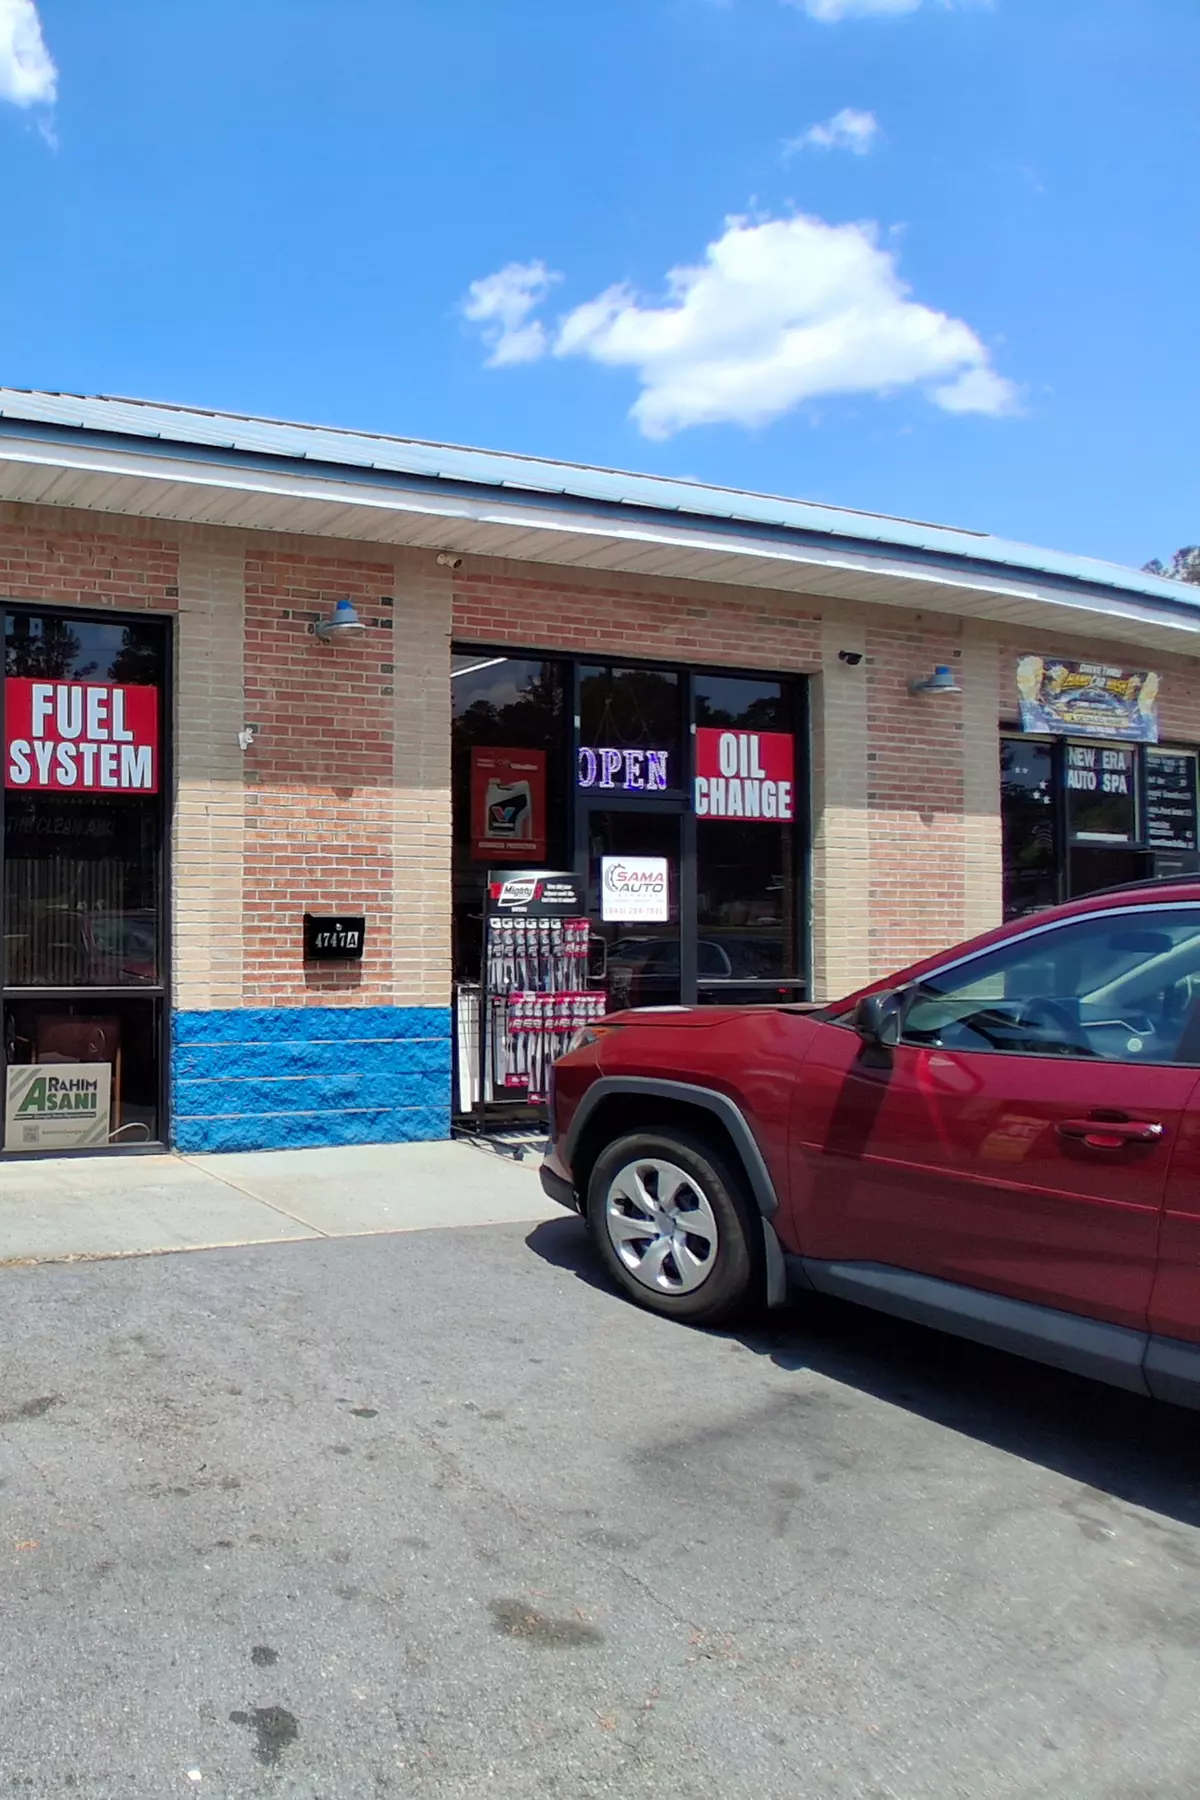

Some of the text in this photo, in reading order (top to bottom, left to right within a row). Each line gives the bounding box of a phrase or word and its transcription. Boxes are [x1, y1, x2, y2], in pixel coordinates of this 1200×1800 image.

[31, 684, 133, 742] FUEL
[9, 740, 153, 789] SYSTEM
[577, 747, 668, 790] OPEN
[719, 733, 766, 778] OIL
[1068, 747, 1095, 767] NEW
[1102, 751, 1126, 771] ERA
[694, 777, 792, 819] CHANGE
[1067, 770, 1096, 791] AUTO
[1102, 773, 1128, 794] SPA
[616, 871, 664, 882] SAMA
[619, 883, 664, 892] AUTO
[18, 1077, 97, 1112] ASANI
[48, 1077, 97, 1092] RAHIM
